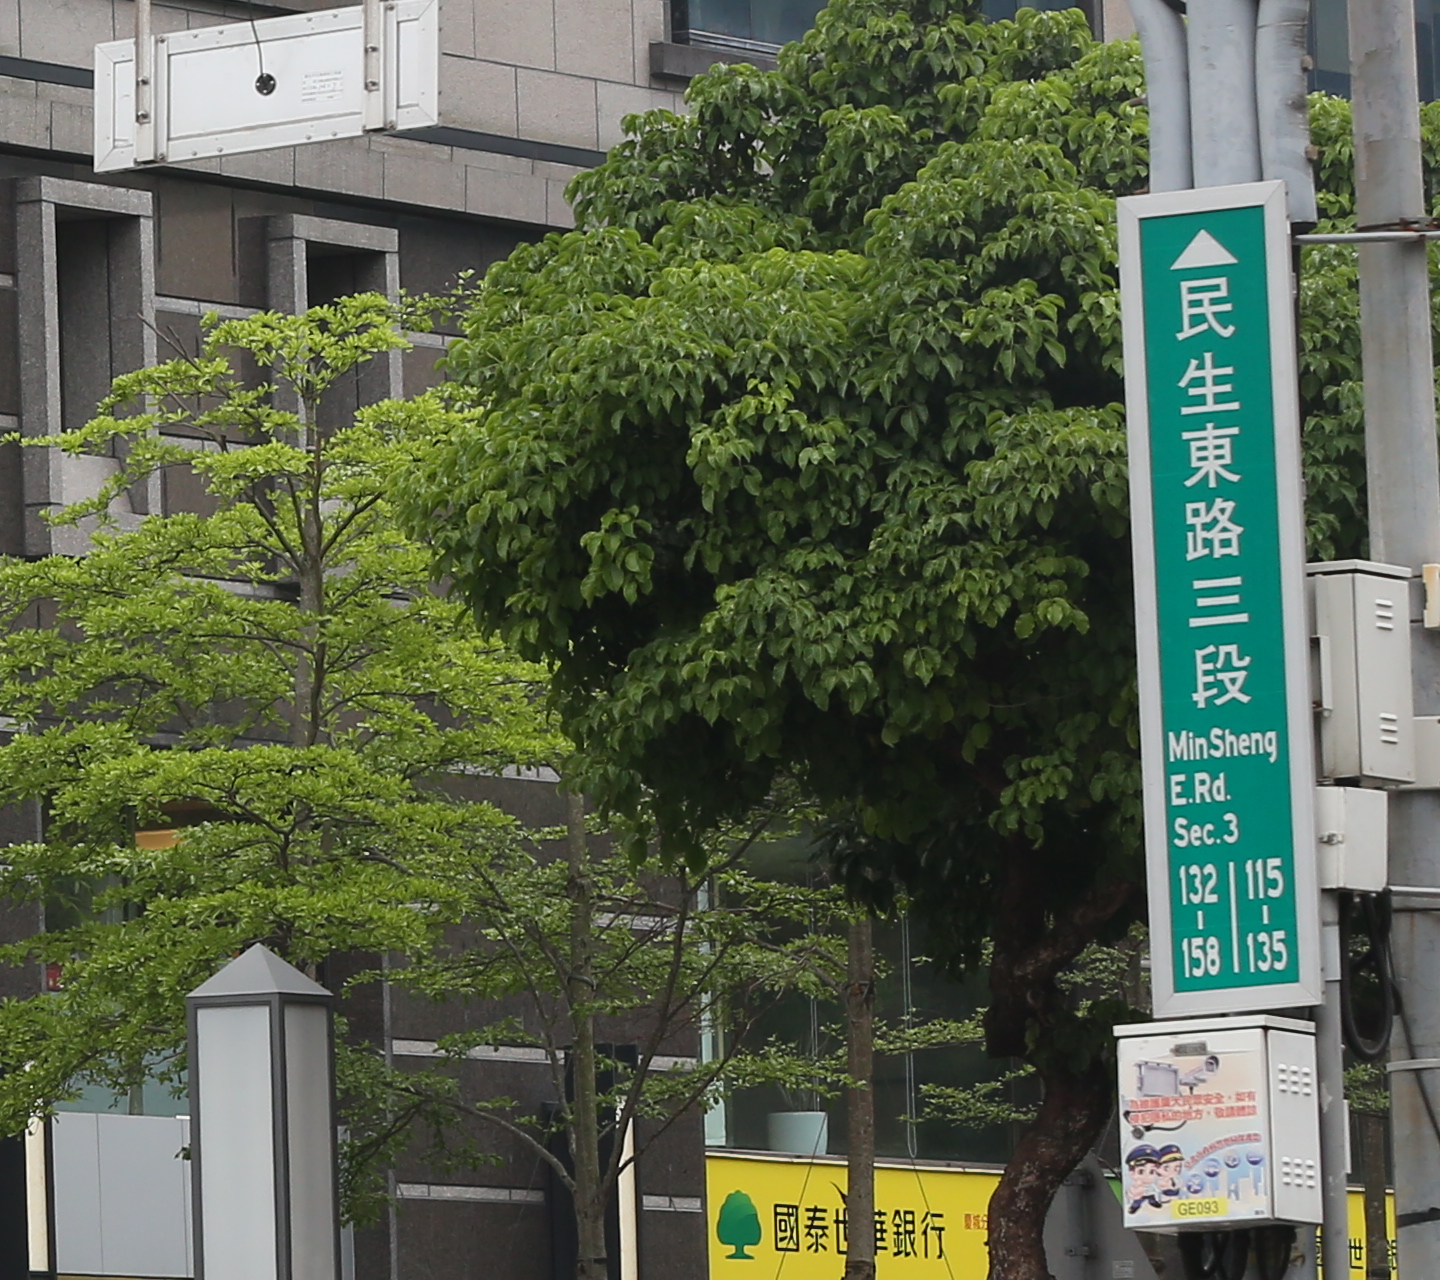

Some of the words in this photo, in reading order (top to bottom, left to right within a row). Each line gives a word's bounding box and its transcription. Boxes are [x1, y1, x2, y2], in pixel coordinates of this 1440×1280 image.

[1175, 276, 1253, 709] 民生東路三段
[1170, 772, 1232, 806] E.Rd.
[1173, 812, 1239, 847] Sec.3
[1180, 863, 1219, 905] 132
[1245, 857, 1284, 899] 115
[1182, 936, 1221, 978] 158
[1247, 930, 1288, 973] 135
[1177, 1200, 1220, 1216] GE093
